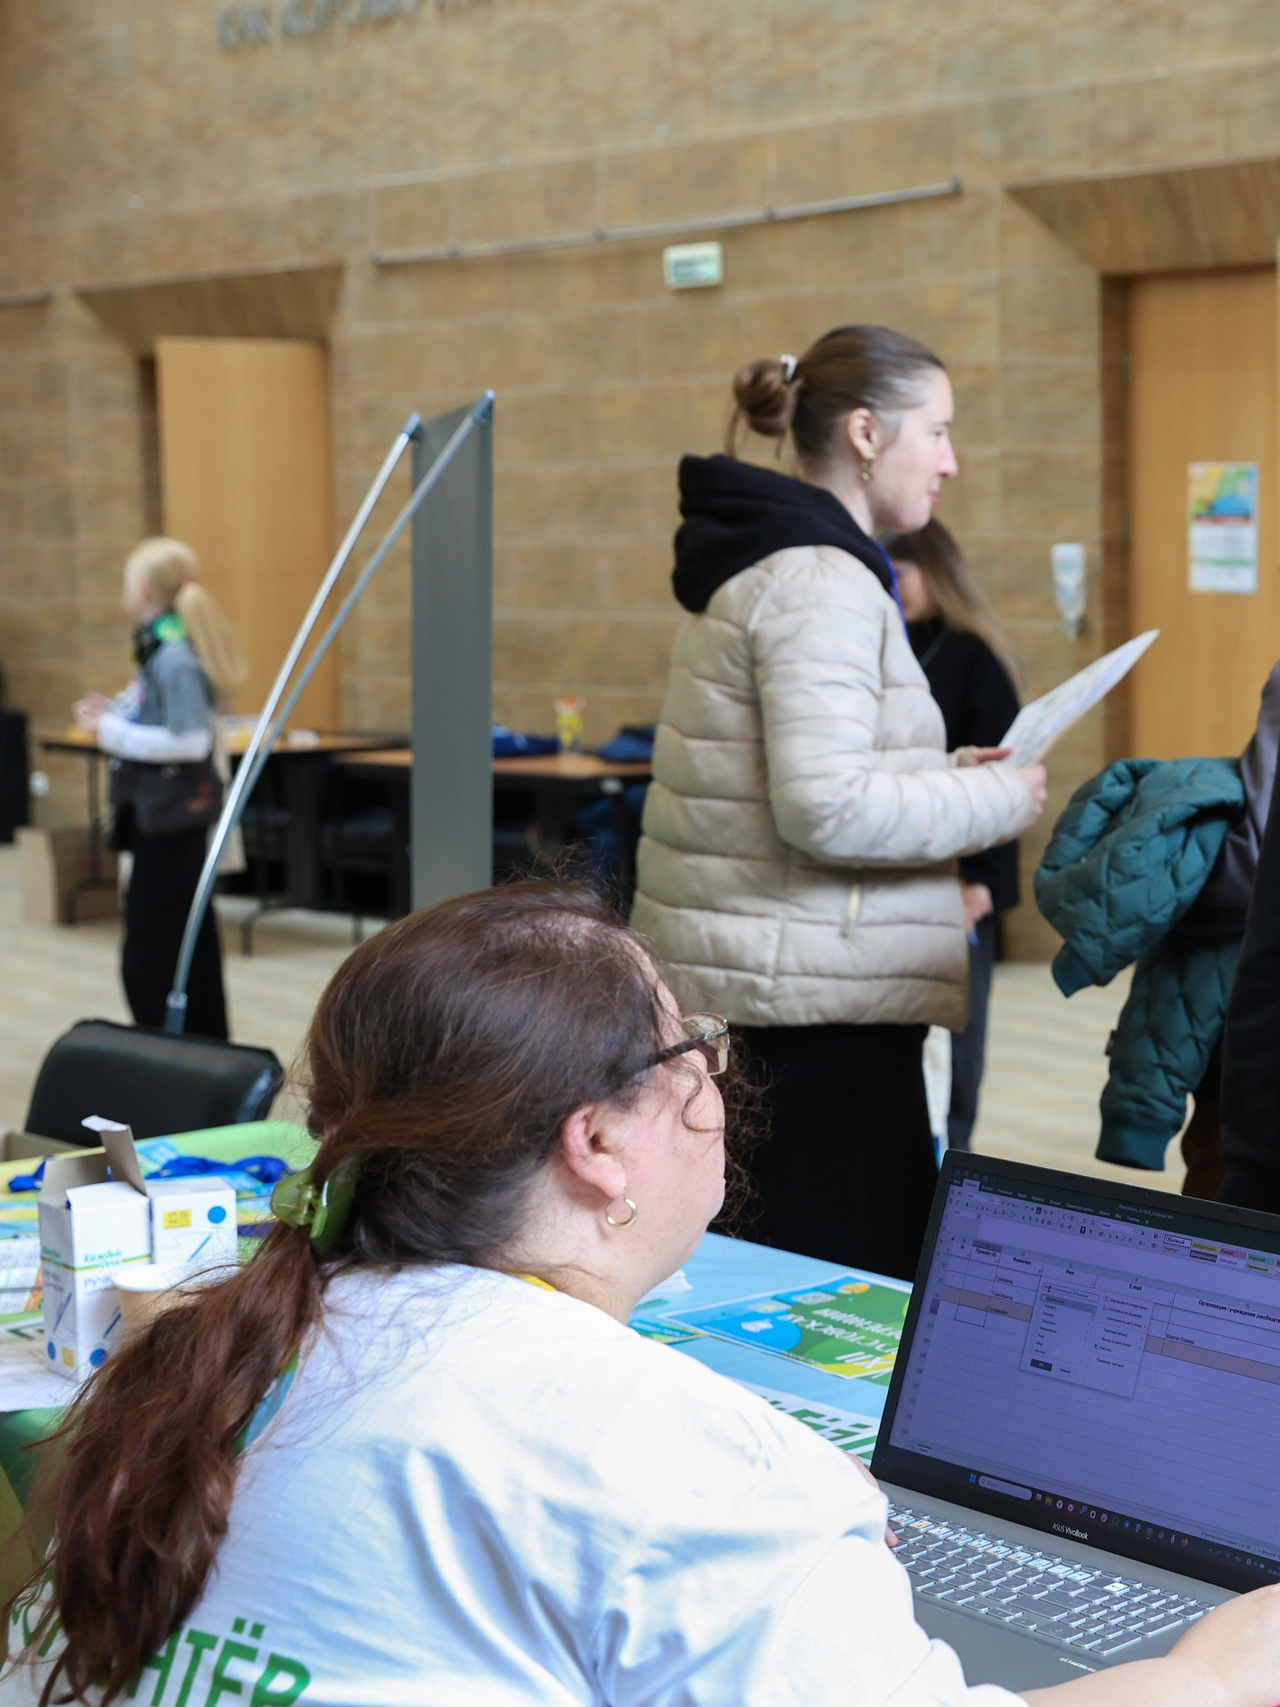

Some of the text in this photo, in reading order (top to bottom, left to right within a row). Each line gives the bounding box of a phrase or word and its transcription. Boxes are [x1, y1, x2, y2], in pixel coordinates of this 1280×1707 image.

[1165, 1236, 1185, 1245] Обычный
[1128, 1283, 1142, 1291] E-mail
[1198, 1299, 1226, 1310] Организация
[1229, 1306, 1255, 1317] учреждение
[1051, 1523, 1088, 1540] ASUS VivoBook
